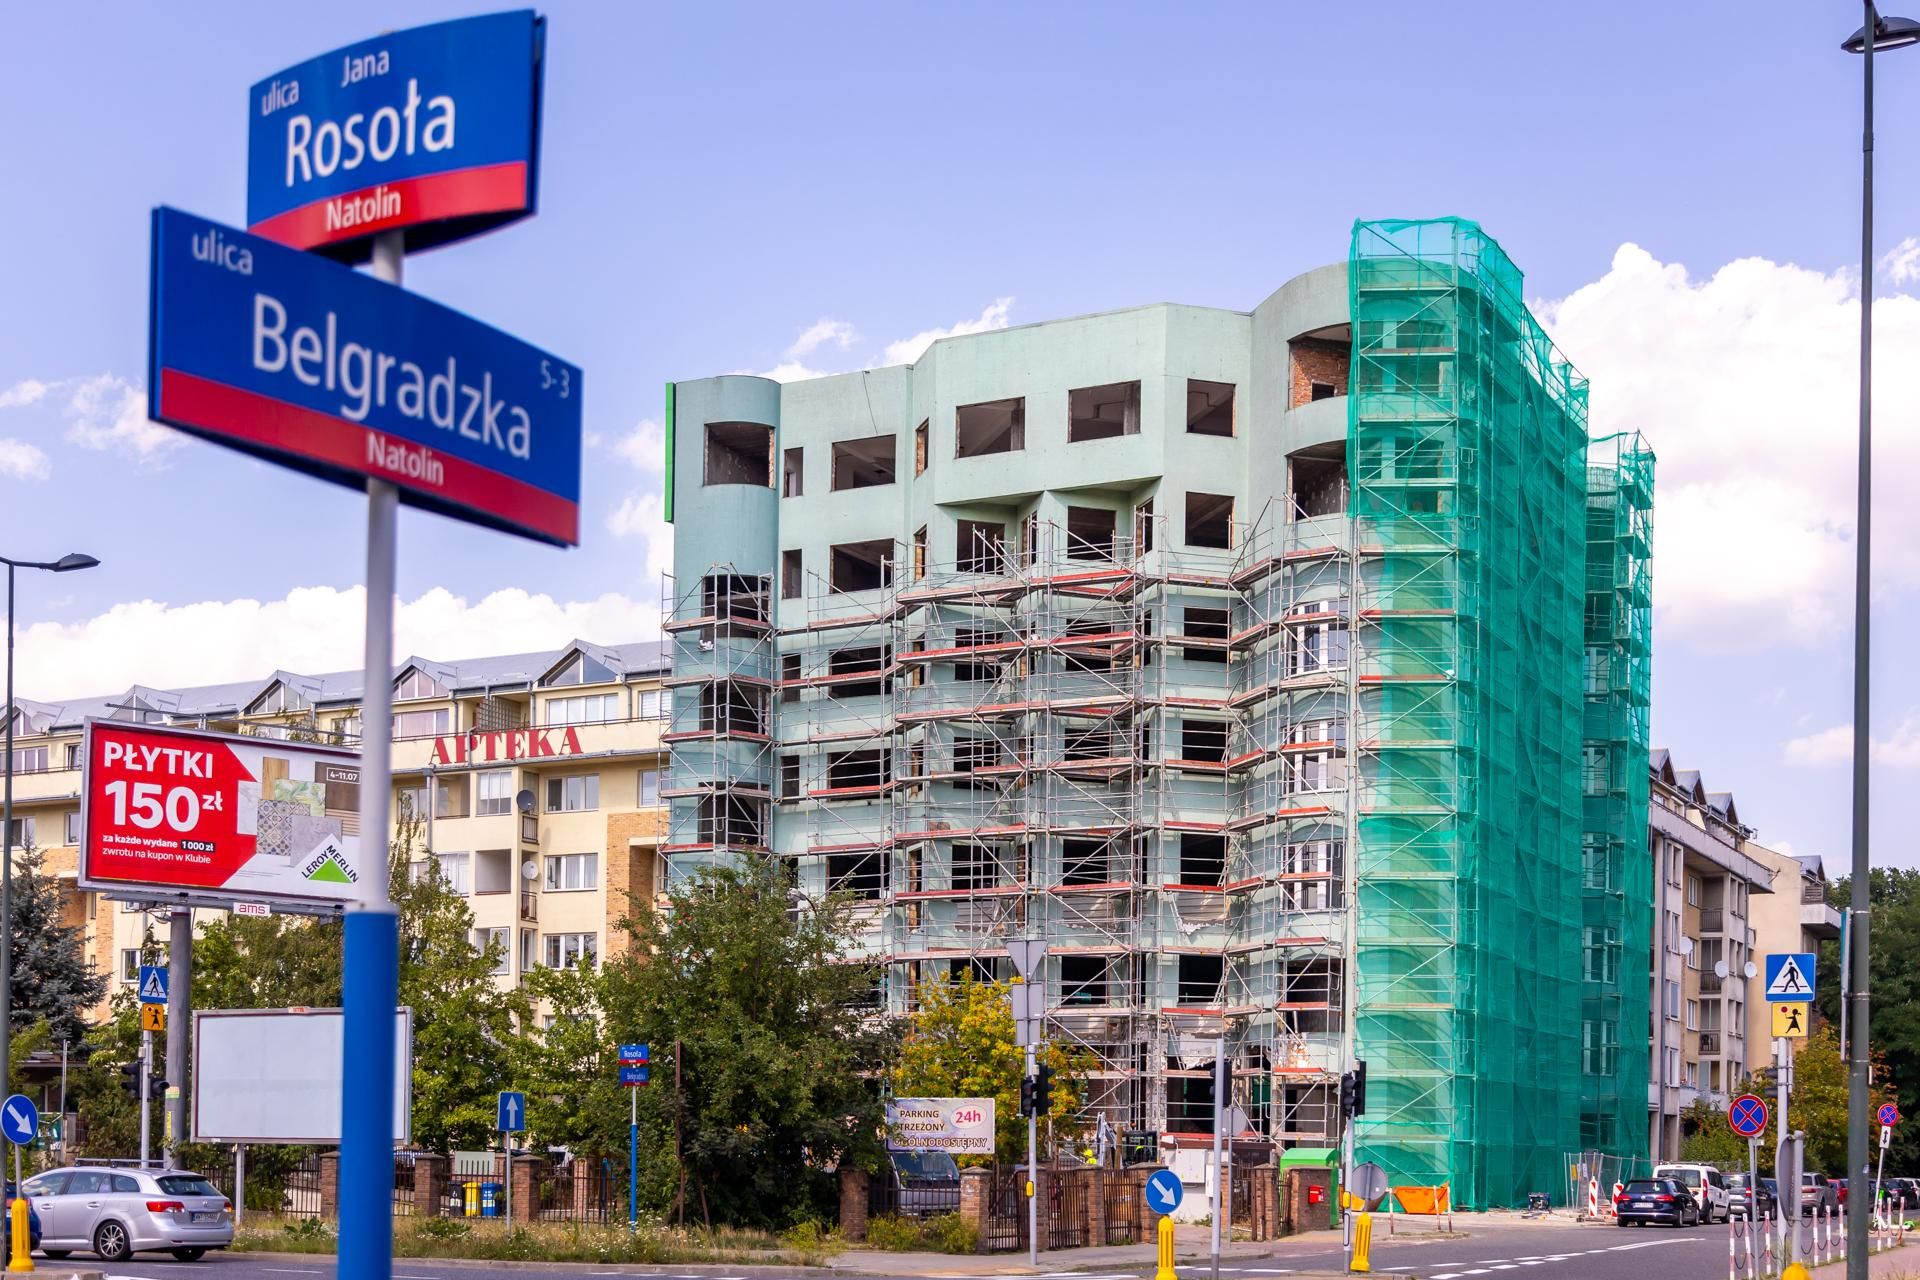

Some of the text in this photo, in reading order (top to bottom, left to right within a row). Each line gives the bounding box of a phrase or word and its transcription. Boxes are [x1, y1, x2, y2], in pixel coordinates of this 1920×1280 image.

[341, 50, 390, 88] Jana
[261, 80, 300, 117] ulica
[285, 77, 456, 188] Rosoła
[325, 186, 402, 233] Natolin
[192, 228, 254, 276] ulica
[252, 292, 532, 461] Belgradzka
[365, 431, 445, 487] Natolin
[103, 740, 214, 779] PŁYTKI
[428, 725, 584, 766] APTEKA
[329, 771, 359, 782] 4-11.07
[104, 779, 201, 833] 150
[102, 834, 114, 843] za
[115, 834, 142, 845] każde
[143, 838, 178, 849] wydane
[102, 847, 212, 864] zwrotu na kupon w Klubie
[302, 844, 360, 884] LEROY MERLIN
[238, 904, 266, 915] ams
[896, 1121, 945, 1132] TRZEŻONY
[900, 1110, 939, 1119] PARKING
[955, 1110, 982, 1124] 24h
